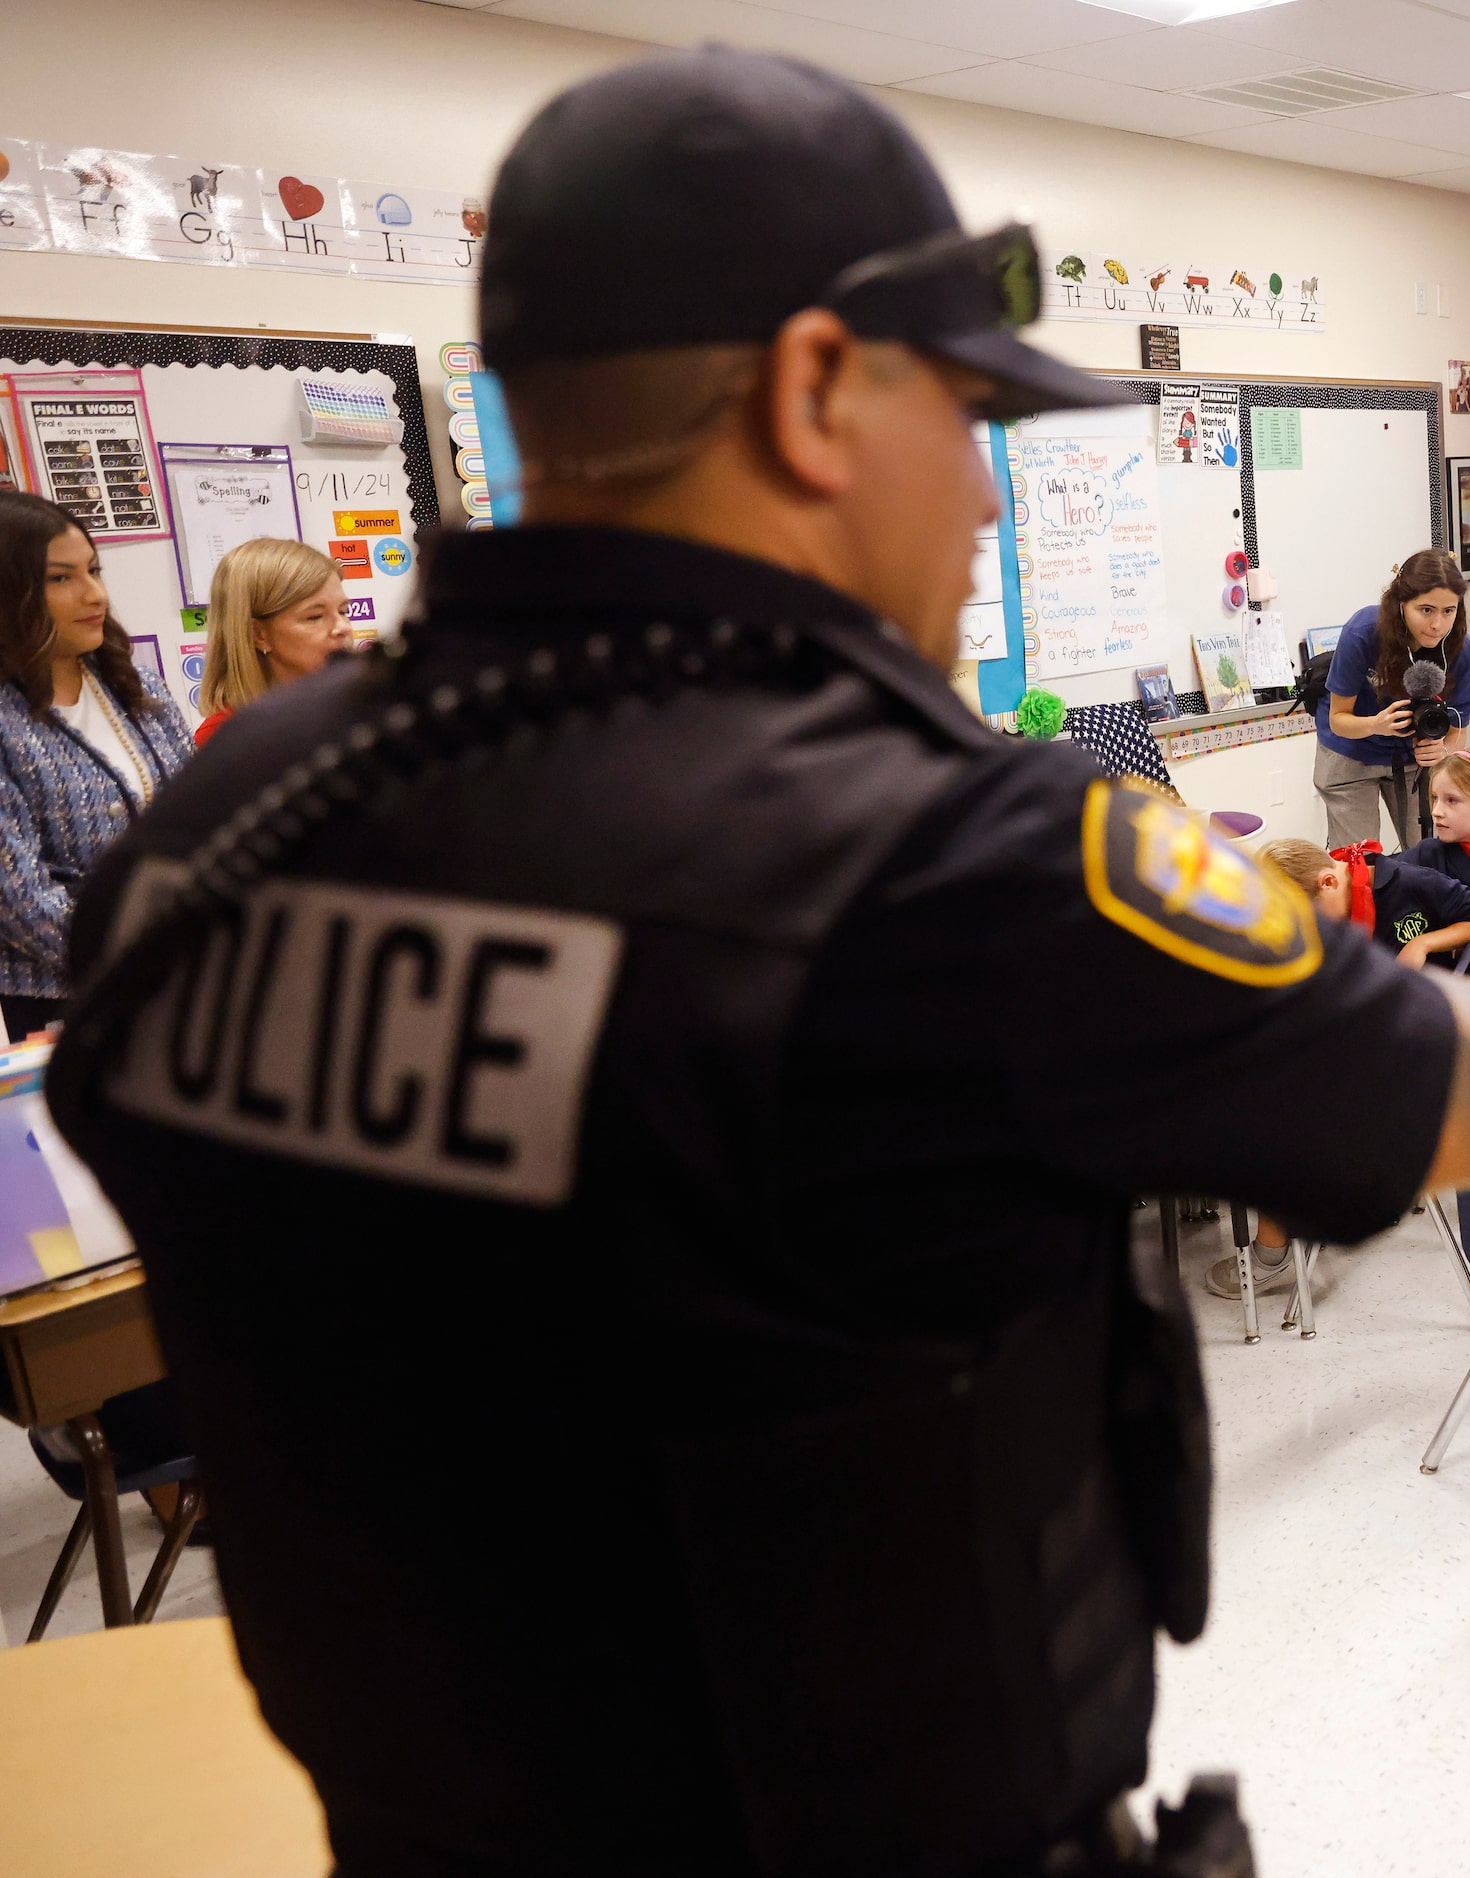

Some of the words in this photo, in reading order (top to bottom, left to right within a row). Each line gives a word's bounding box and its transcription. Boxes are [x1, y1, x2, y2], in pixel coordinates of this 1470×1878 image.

[80, 200, 127, 236] Ff
[180, 212, 234, 261] Gg
[282, 220, 328, 255] Hh
[381, 231, 406, 262] Ii
[1062, 285, 1081, 307] Tt
[1104, 289, 1126, 311] Uu
[1147, 291, 1165, 313] Vv
[1183, 294, 1213, 316] Ww
[1232, 297, 1250, 318] Xx
[1266, 300, 1284, 329] Yy
[1300, 303, 1316, 322] Zz
[1201, 391, 1237, 402] SUMMARY
[34, 405, 73, 415] FINAL
[76, 405, 84, 415] E
[86, 404, 134, 415] WORDS
[1200, 404, 1236, 416] Somebody
[37, 420, 55, 428] Final
[1200, 417, 1226, 427] Wanted
[67, 428, 81, 436] say
[1202, 429, 1214, 439] But
[48, 446, 69, 454] cake
[1203, 442, 1212, 452] So
[51, 460, 77, 469] game
[103, 459, 125, 467] cave
[1203, 456, 1220, 465] Then
[55, 476, 75, 486] bike
[296, 473, 390, 501] 9/11/24
[1046, 478, 1067, 495] What
[1073, 482, 1080, 493] is
[1083, 481, 1090, 493] a
[59, 492, 78, 500] time
[213, 486, 251, 498] Spelling
[118, 518, 137, 527] rose
[354, 517, 395, 528] summer
[1041, 527, 1078, 540] Somebody
[1081, 528, 1095, 537] who
[1111, 524, 1144, 535] Somebody
[341, 543, 356, 553] hot
[1038, 537, 1072, 551] Protects
[1076, 538, 1086, 547] us
[381, 553, 406, 562] sunny
[1037, 557, 1074, 569] Somebody
[1111, 585, 1137, 599] Brave
[1041, 605, 1097, 623] Courageous
[1111, 620, 1150, 640] Amazing
[1044, 627, 1078, 647] Strong
[1048, 650, 1056, 660] a
[1062, 646, 1097, 665] fighter
[1172, 742, 1179, 750] 68
[1182, 740, 1189, 748] 69
[1192, 737, 1199, 746] 70
[1203, 736, 1210, 744] 71
[1247, 728, 1254, 736] 75
[1257, 726, 1264, 734] 76
[125, 900, 556, 1172] OLICE
